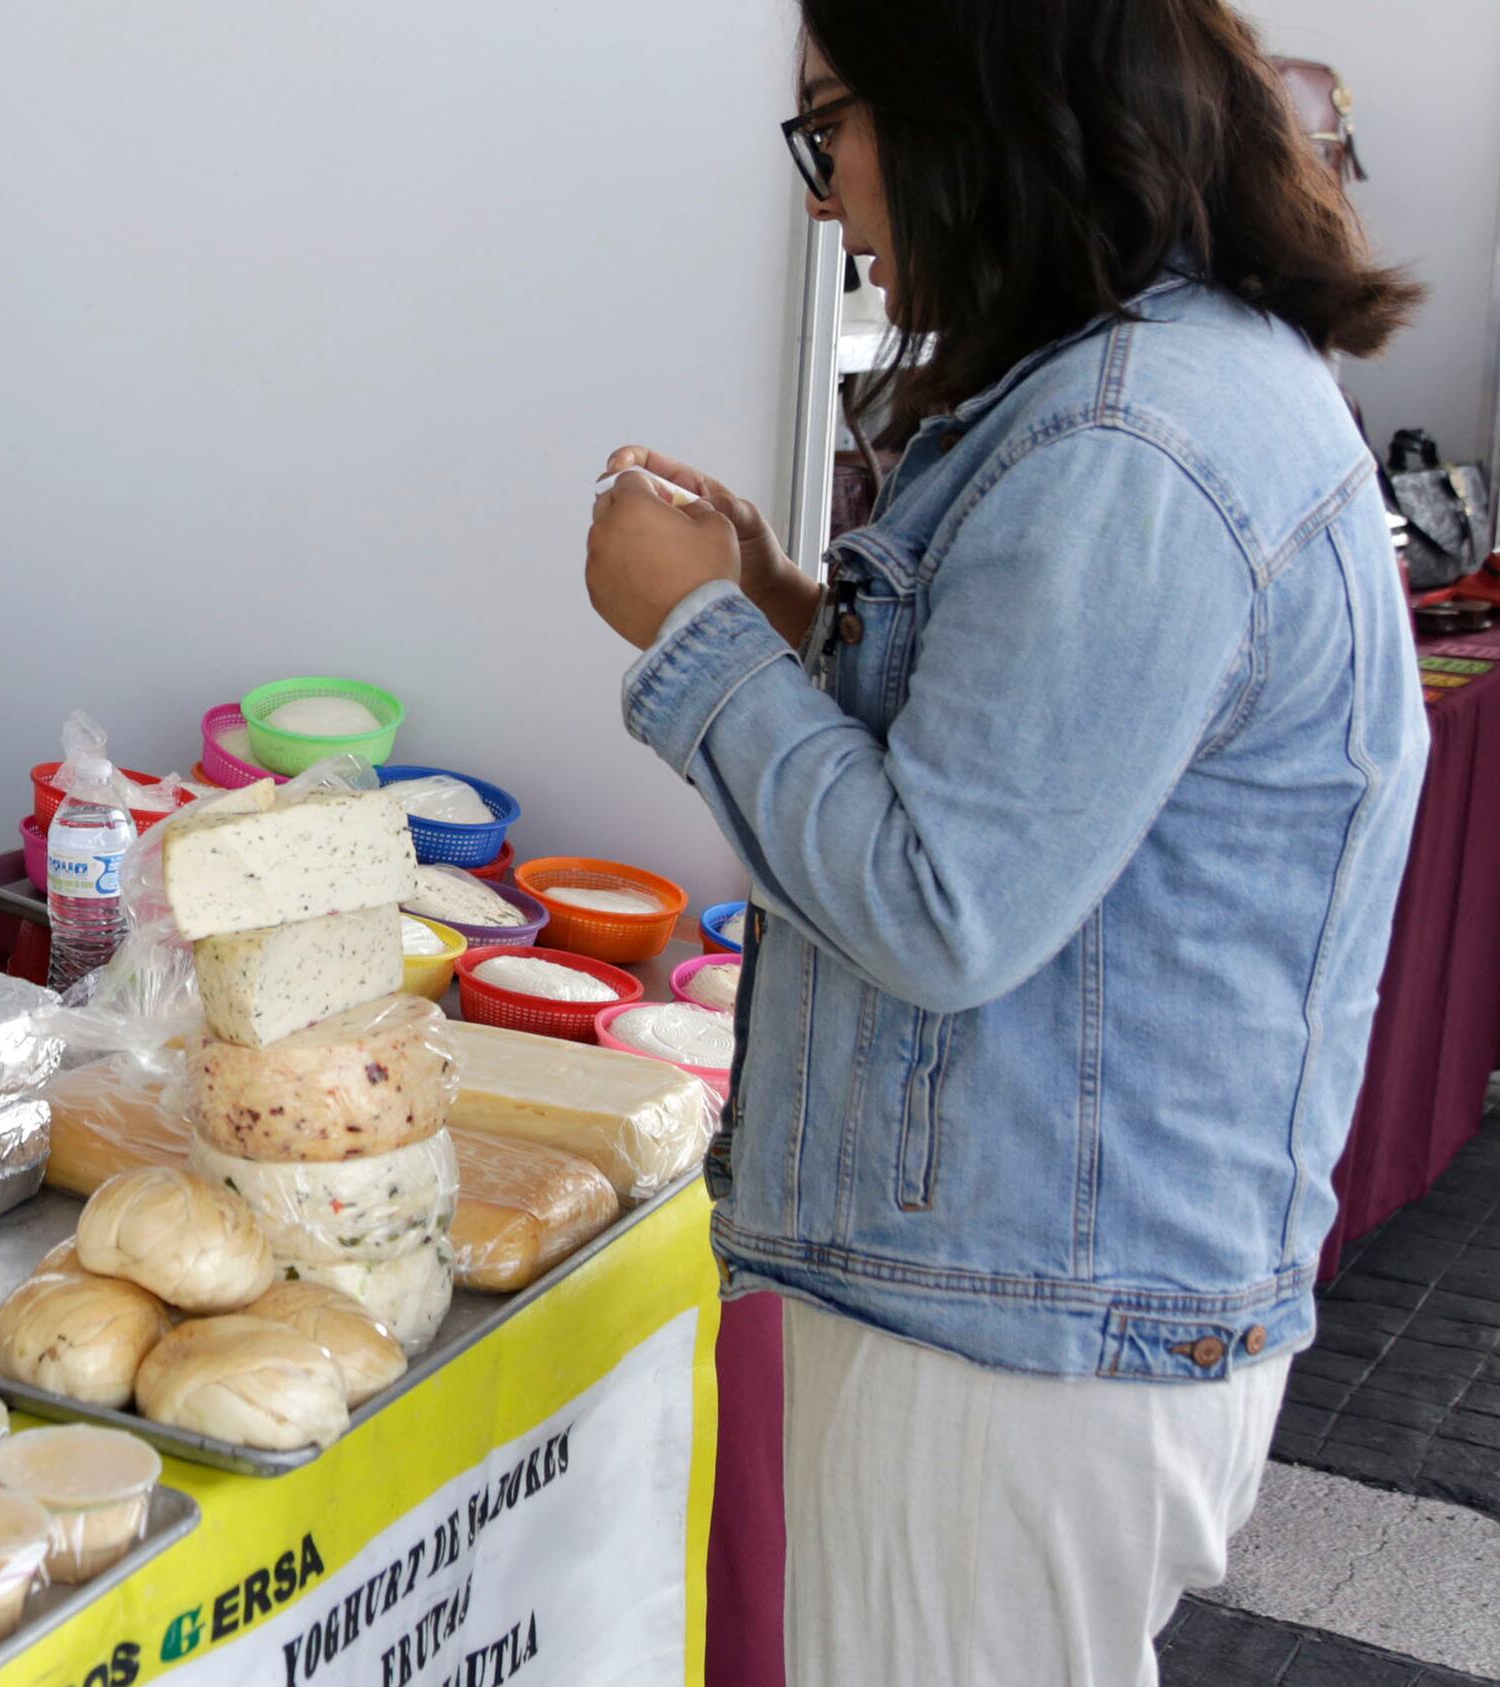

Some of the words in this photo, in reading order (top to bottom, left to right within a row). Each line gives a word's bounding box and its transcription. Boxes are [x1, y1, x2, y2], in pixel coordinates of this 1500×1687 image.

[67, 1641, 141, 1687] OS
[160, 1531, 325, 1663] GERSA
[283, 1539, 426, 1687] YOGHURT
[427, 1508, 460, 1578] DE
[381, 1568, 474, 1687] FRUTAS
